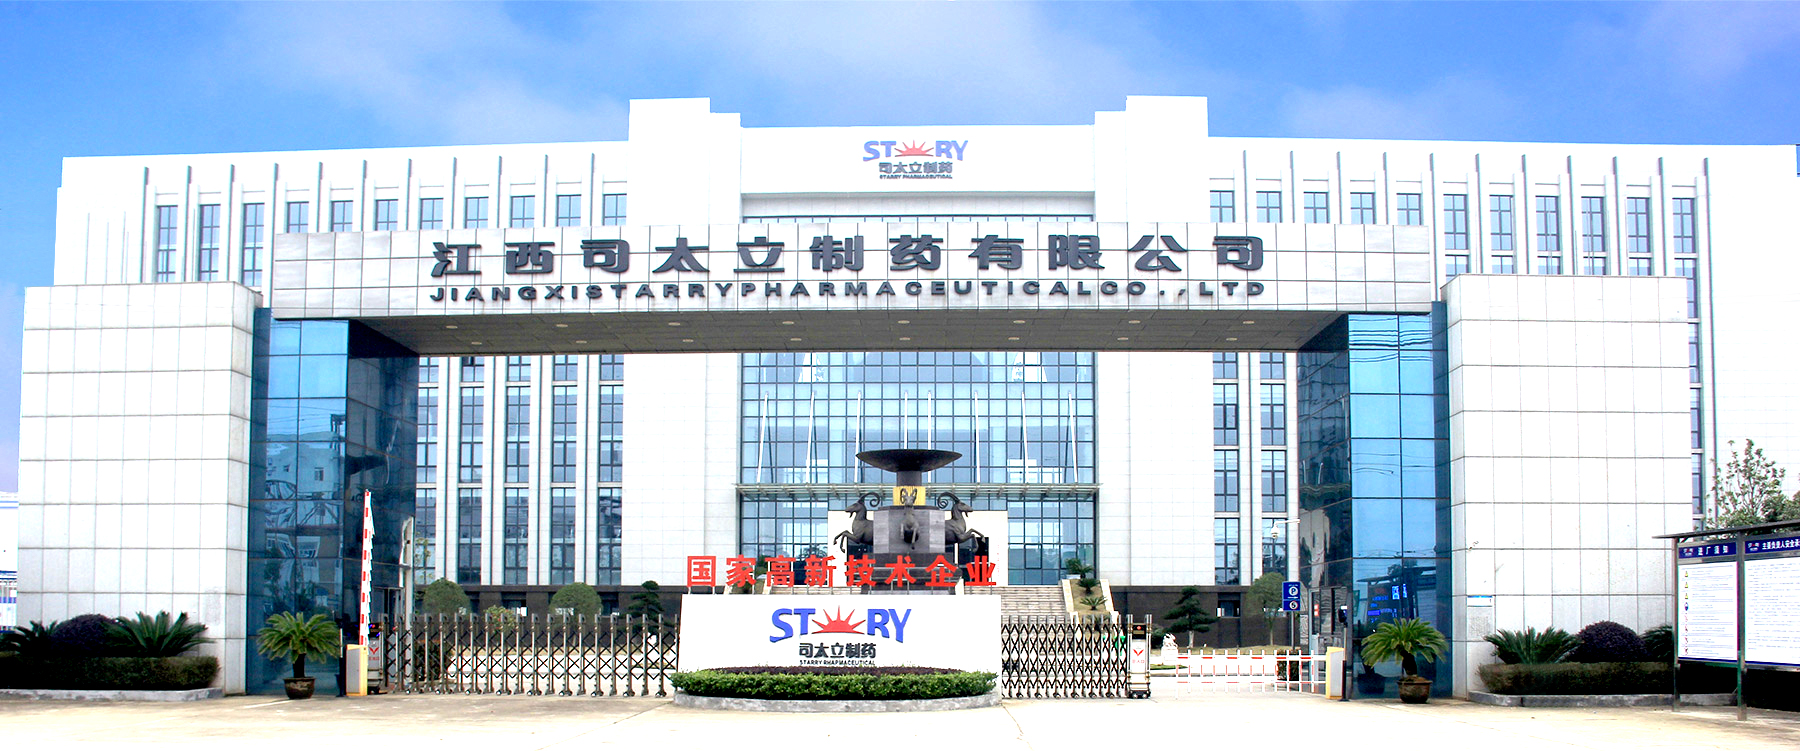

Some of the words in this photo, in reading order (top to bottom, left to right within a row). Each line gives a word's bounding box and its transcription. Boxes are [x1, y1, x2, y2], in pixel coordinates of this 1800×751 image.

[879, 162, 952, 173] 司太立制药
[431, 234, 1263, 277] 江西司太立制药有限公司
[687, 555, 996, 587] 国家高新技术企业
[799, 642, 876, 658] 司太立制药
